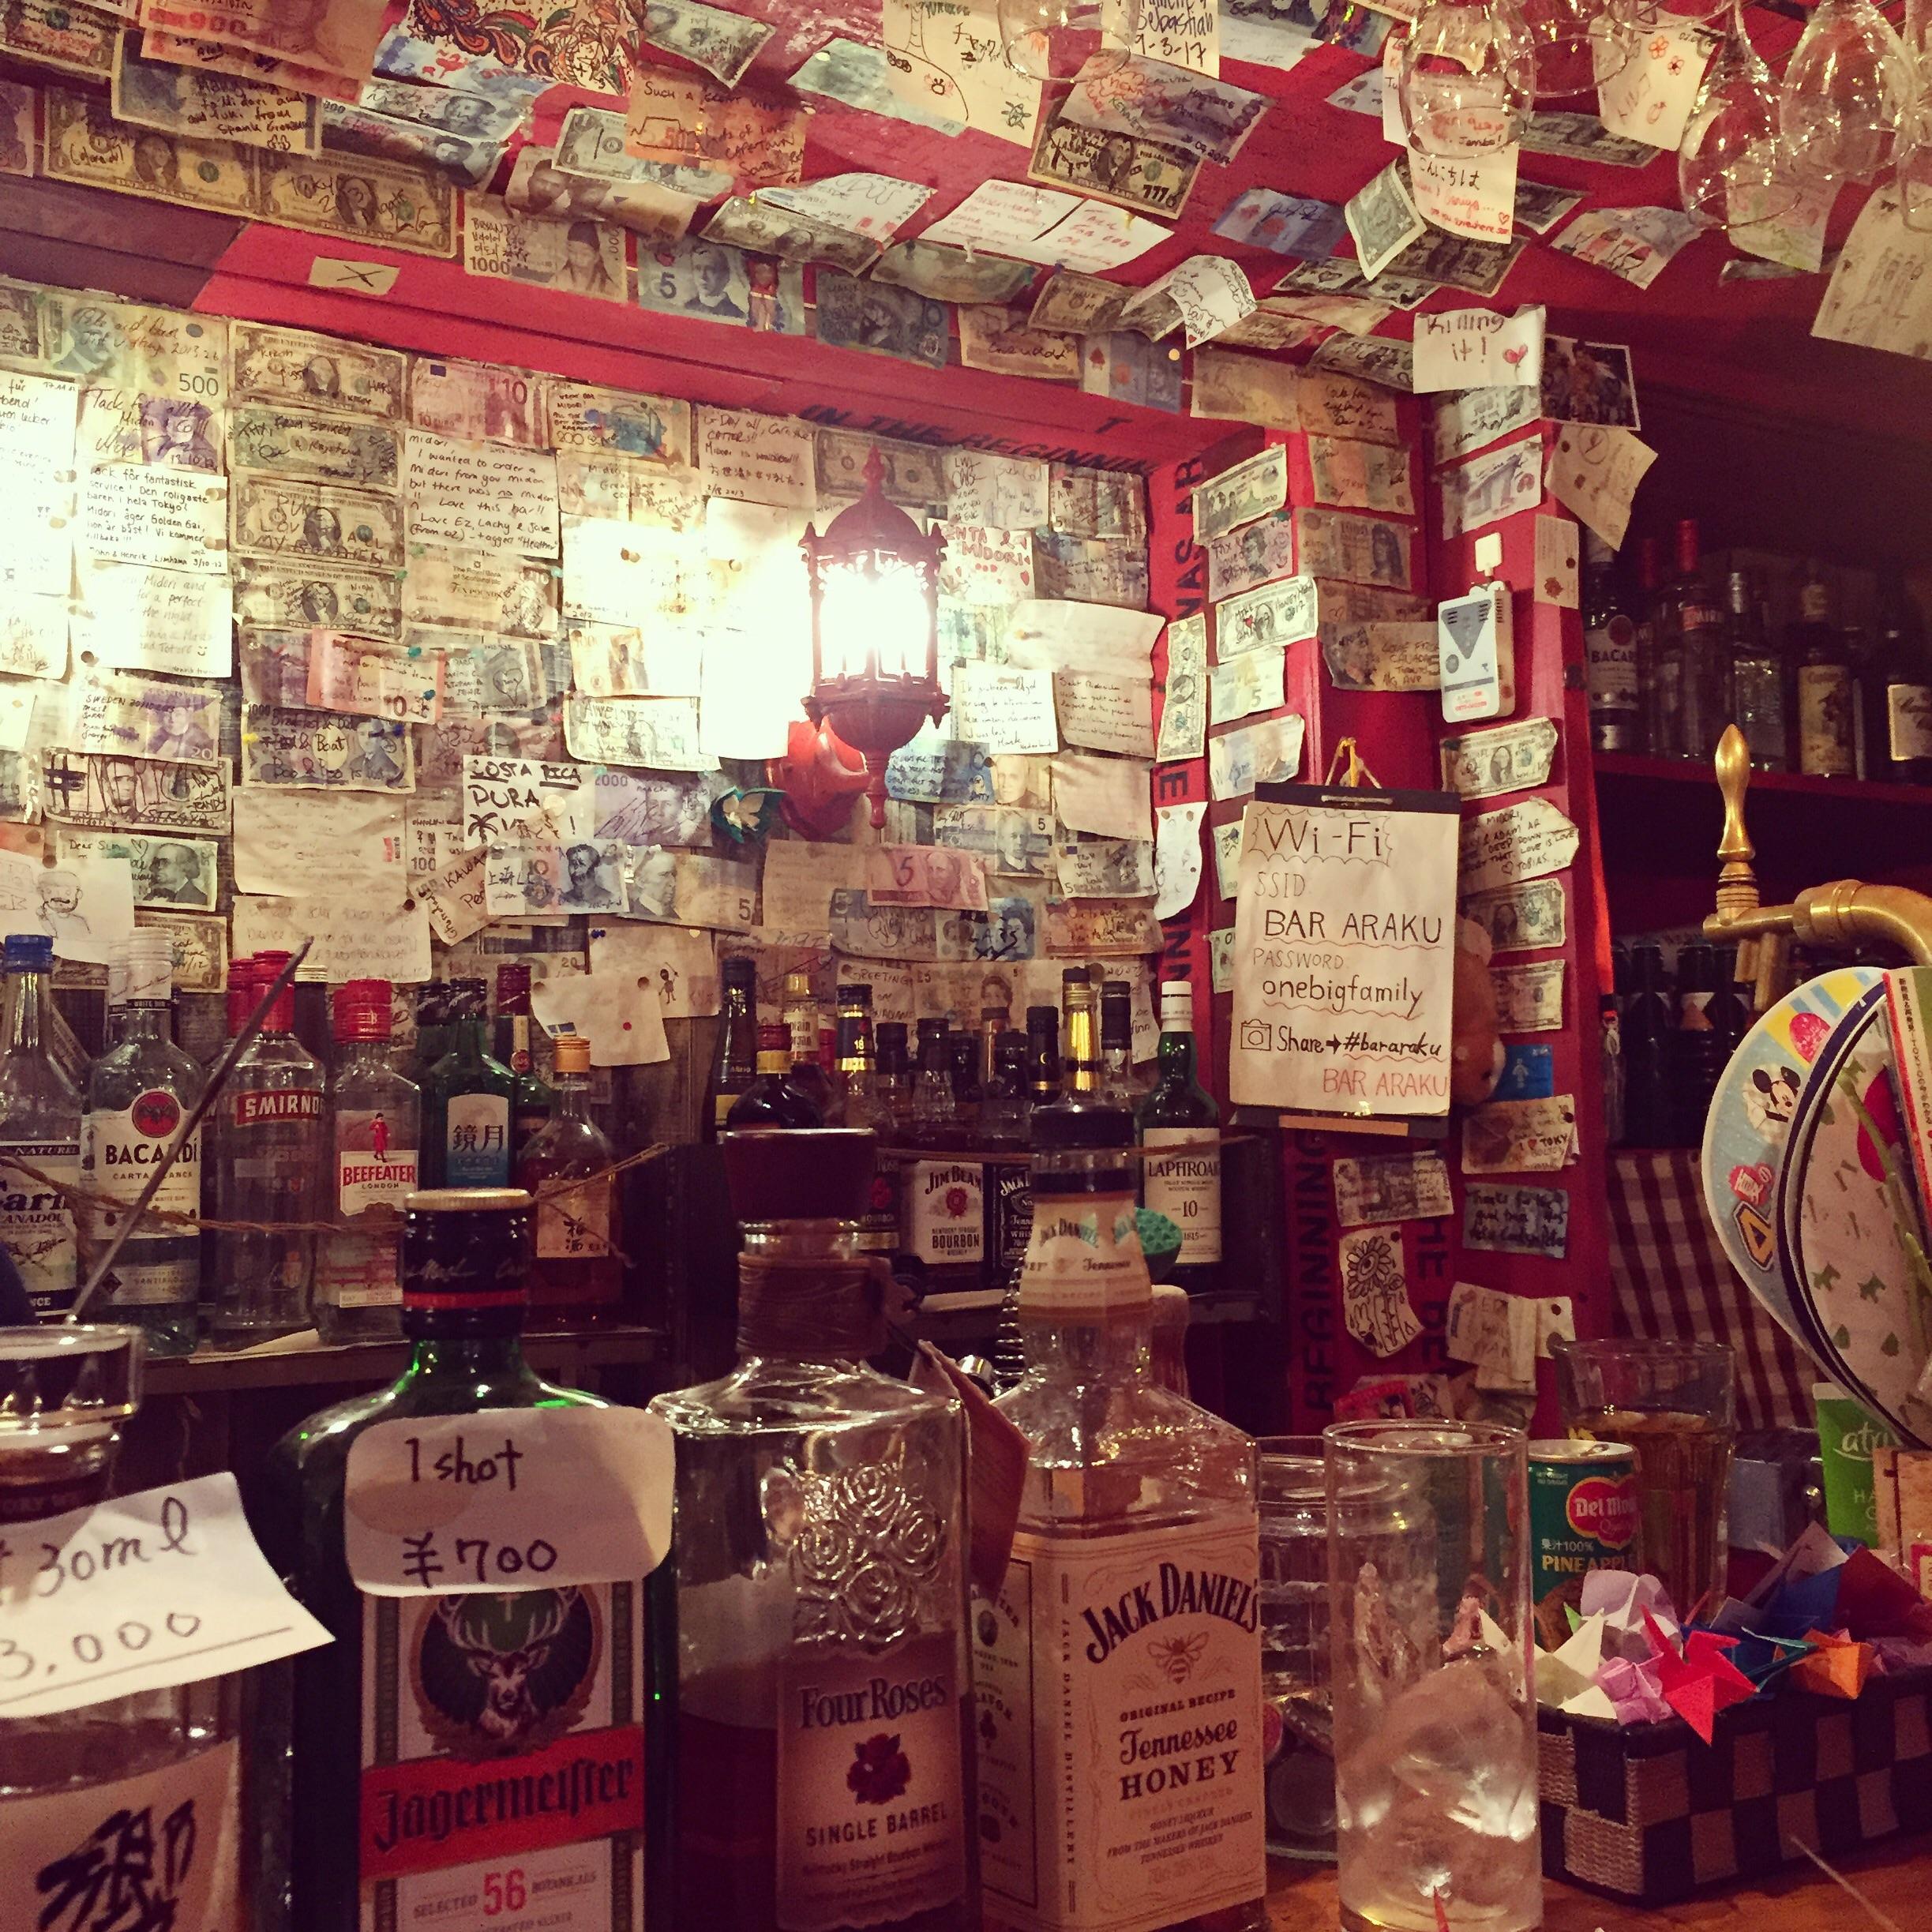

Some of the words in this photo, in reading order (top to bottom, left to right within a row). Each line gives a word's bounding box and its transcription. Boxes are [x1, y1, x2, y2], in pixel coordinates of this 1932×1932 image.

[660, 272, 677, 299] 5
[1451, 338, 1487, 364] it!
[178, 373, 219, 396] 500
[429, 452, 471, 465] wanted
[432, 481, 461, 493] there
[456, 470, 478, 480] from
[439, 498, 466, 510] Love
[477, 503, 501, 513] this
[421, 513, 448, 525] Love
[961, 542, 1024, 565] MIDORI
[1252, 688, 1262, 707] 5
[191, 748, 212, 760] 20
[540, 764, 581, 783] RICA
[468, 784, 540, 808] PURA
[1037, 818, 1046, 831] 5
[1263, 818, 1382, 856] Wi-Fi
[411, 857, 436, 872] 100
[1255, 872, 1306, 898] SSID
[739, 898, 751, 921] 5
[1265, 910, 1326, 939] BAR
[1342, 913, 1442, 943] ARAKU
[1252, 947, 1344, 970] PASSWORD
[1262, 974, 1424, 1019] onebigfamily
[853, 1038, 865, 1049] 18
[1277, 1026, 1325, 1053] Share
[1342, 1031, 1442, 1056] #bararaku
[1323, 1068, 1367, 1097] BAR
[1375, 1072, 1448, 1097] ARAKU
[452, 1124, 504, 1153] 鏡月
[343, 1165, 417, 1187] BEEFEATER
[925, 1170, 949, 1195] JIM
[1183, 1199, 1198, 1217] 10
[932, 1234, 979, 1248] BOURBON
[433, 1435, 523, 1490] shot
[1576, 1499, 1604, 1517] Del
[403, 1531, 558, 1589] ¥700
[1079, 1582, 1158, 1664] JACK
[1159, 1562, 1262, 1634] DANIEL'S
[798, 1685, 868, 1729] Four
[868, 1675, 947, 1720] Roses
[1120, 1701, 1184, 1722] ORIGINAL
[1189, 1689, 1236, 1708] RECIPE
[1120, 1720, 1237, 1765] Tennessee
[1119, 1750, 1240, 1801] HONEY
[806, 1818, 877, 1848] SINGLE
[887, 1801, 947, 1834] BARREL
[414, 1896, 478, 1919] SELECTED
[483, 1867, 527, 1916] 56
